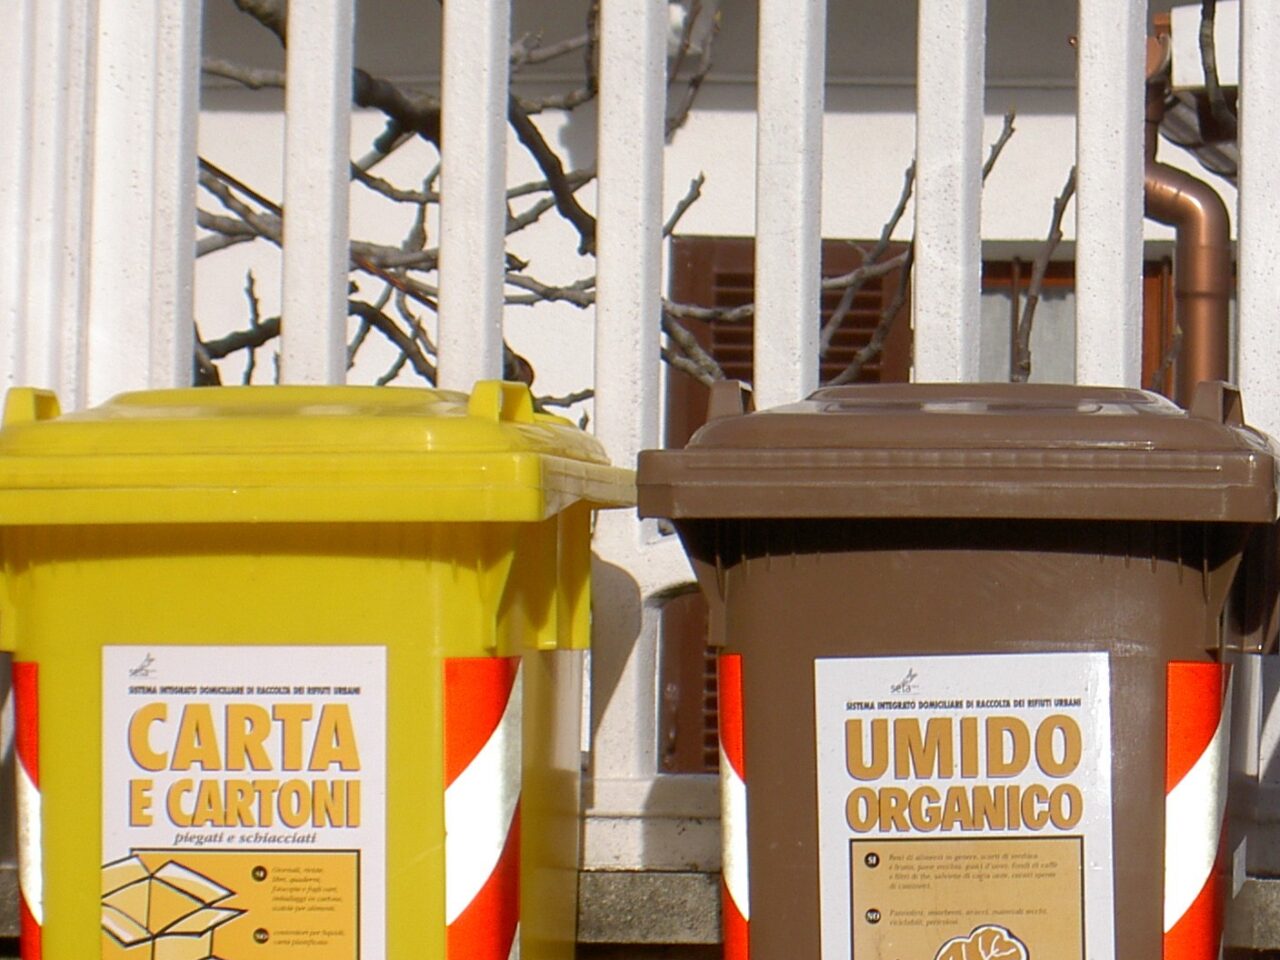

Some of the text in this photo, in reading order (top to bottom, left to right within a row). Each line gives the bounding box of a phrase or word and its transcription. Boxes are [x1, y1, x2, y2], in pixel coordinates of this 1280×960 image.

[846, 698, 1081, 710] SISTEMA INTEGRATO DOMICILIARE DI RACCOLTA DEI RIFIUTI URBANI
[128, 702, 361, 772] CARTA
[845, 714, 1083, 781] UMIDO
[129, 778, 361, 829] E CARTONI
[845, 783, 1083, 833] ORGANICO
[173, 831, 317, 845] piegati e schiacciati
